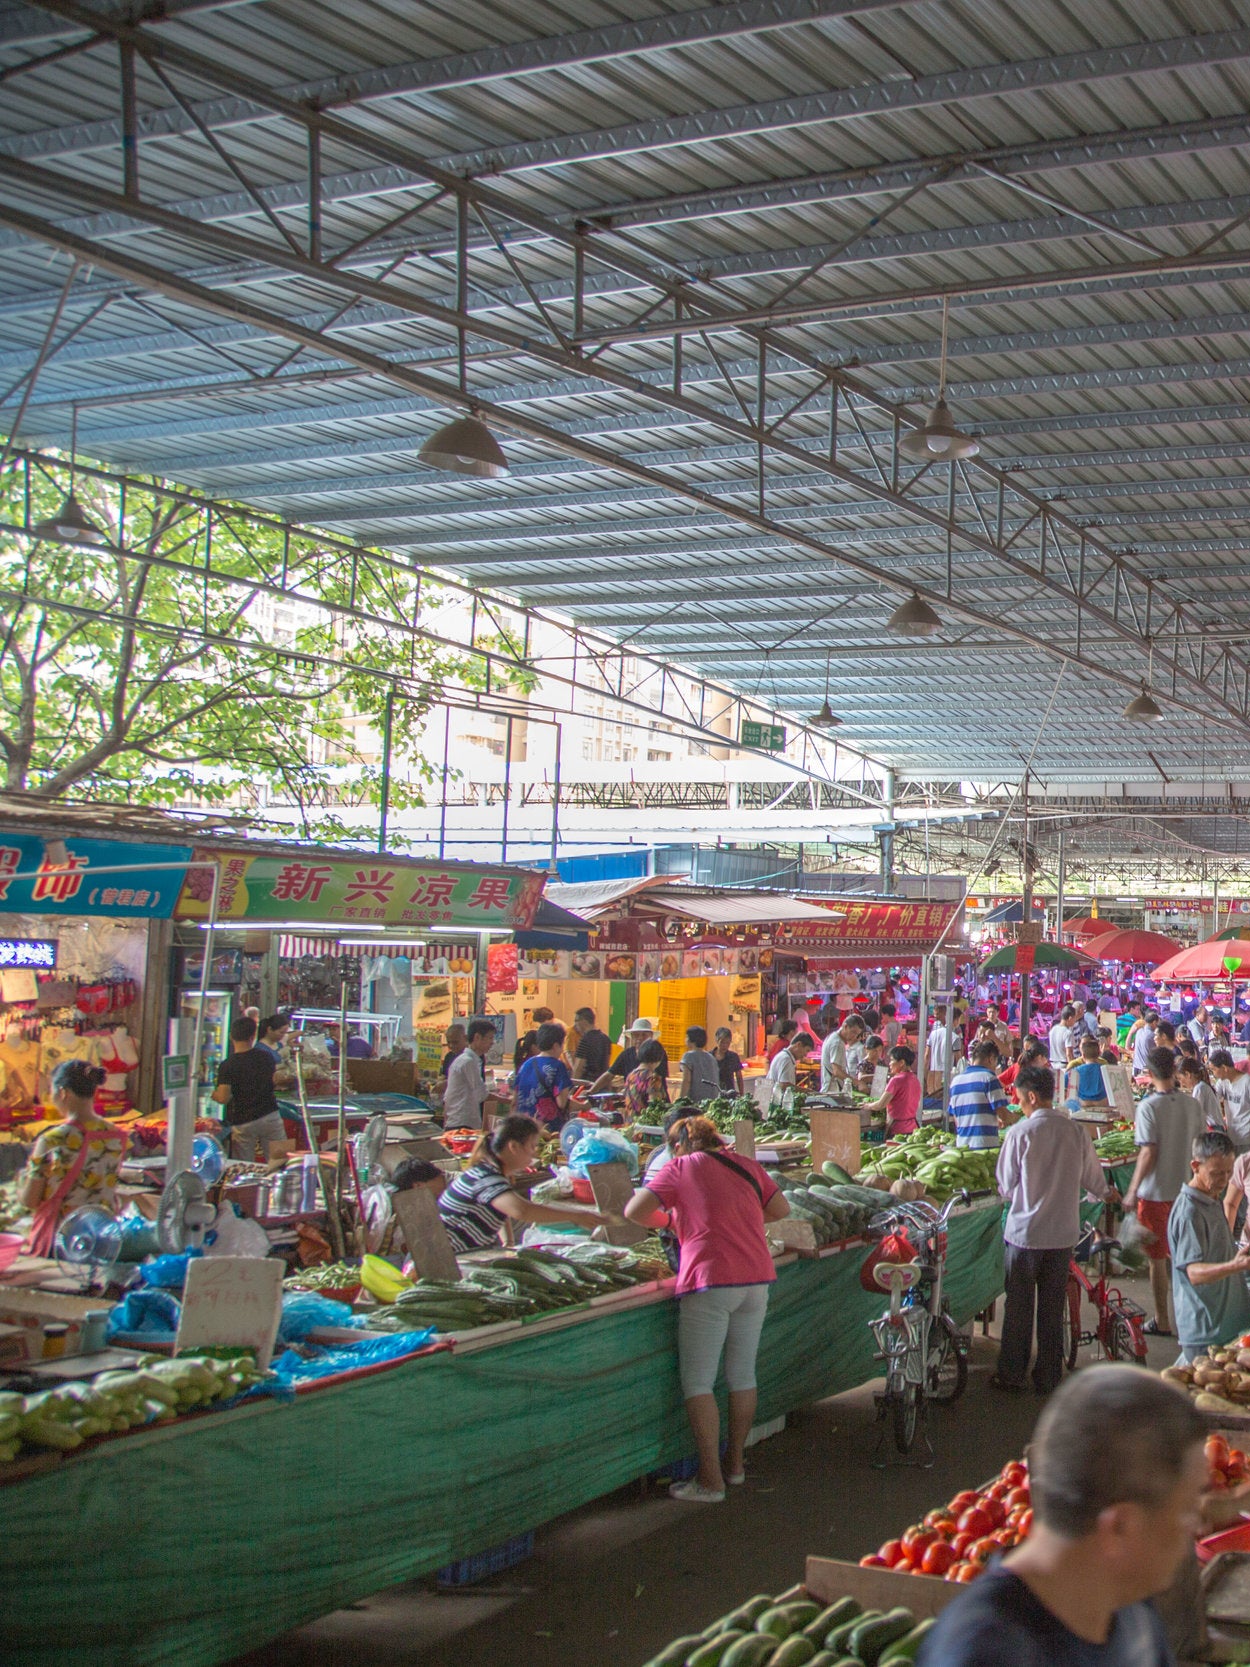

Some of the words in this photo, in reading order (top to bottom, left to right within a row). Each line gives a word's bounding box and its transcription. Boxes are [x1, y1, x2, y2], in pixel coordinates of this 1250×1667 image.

[272, 863, 512, 910] 新兴凉果
[329, 906, 387, 918] 厂家直销
[401, 909, 454, 921] 批发零售
